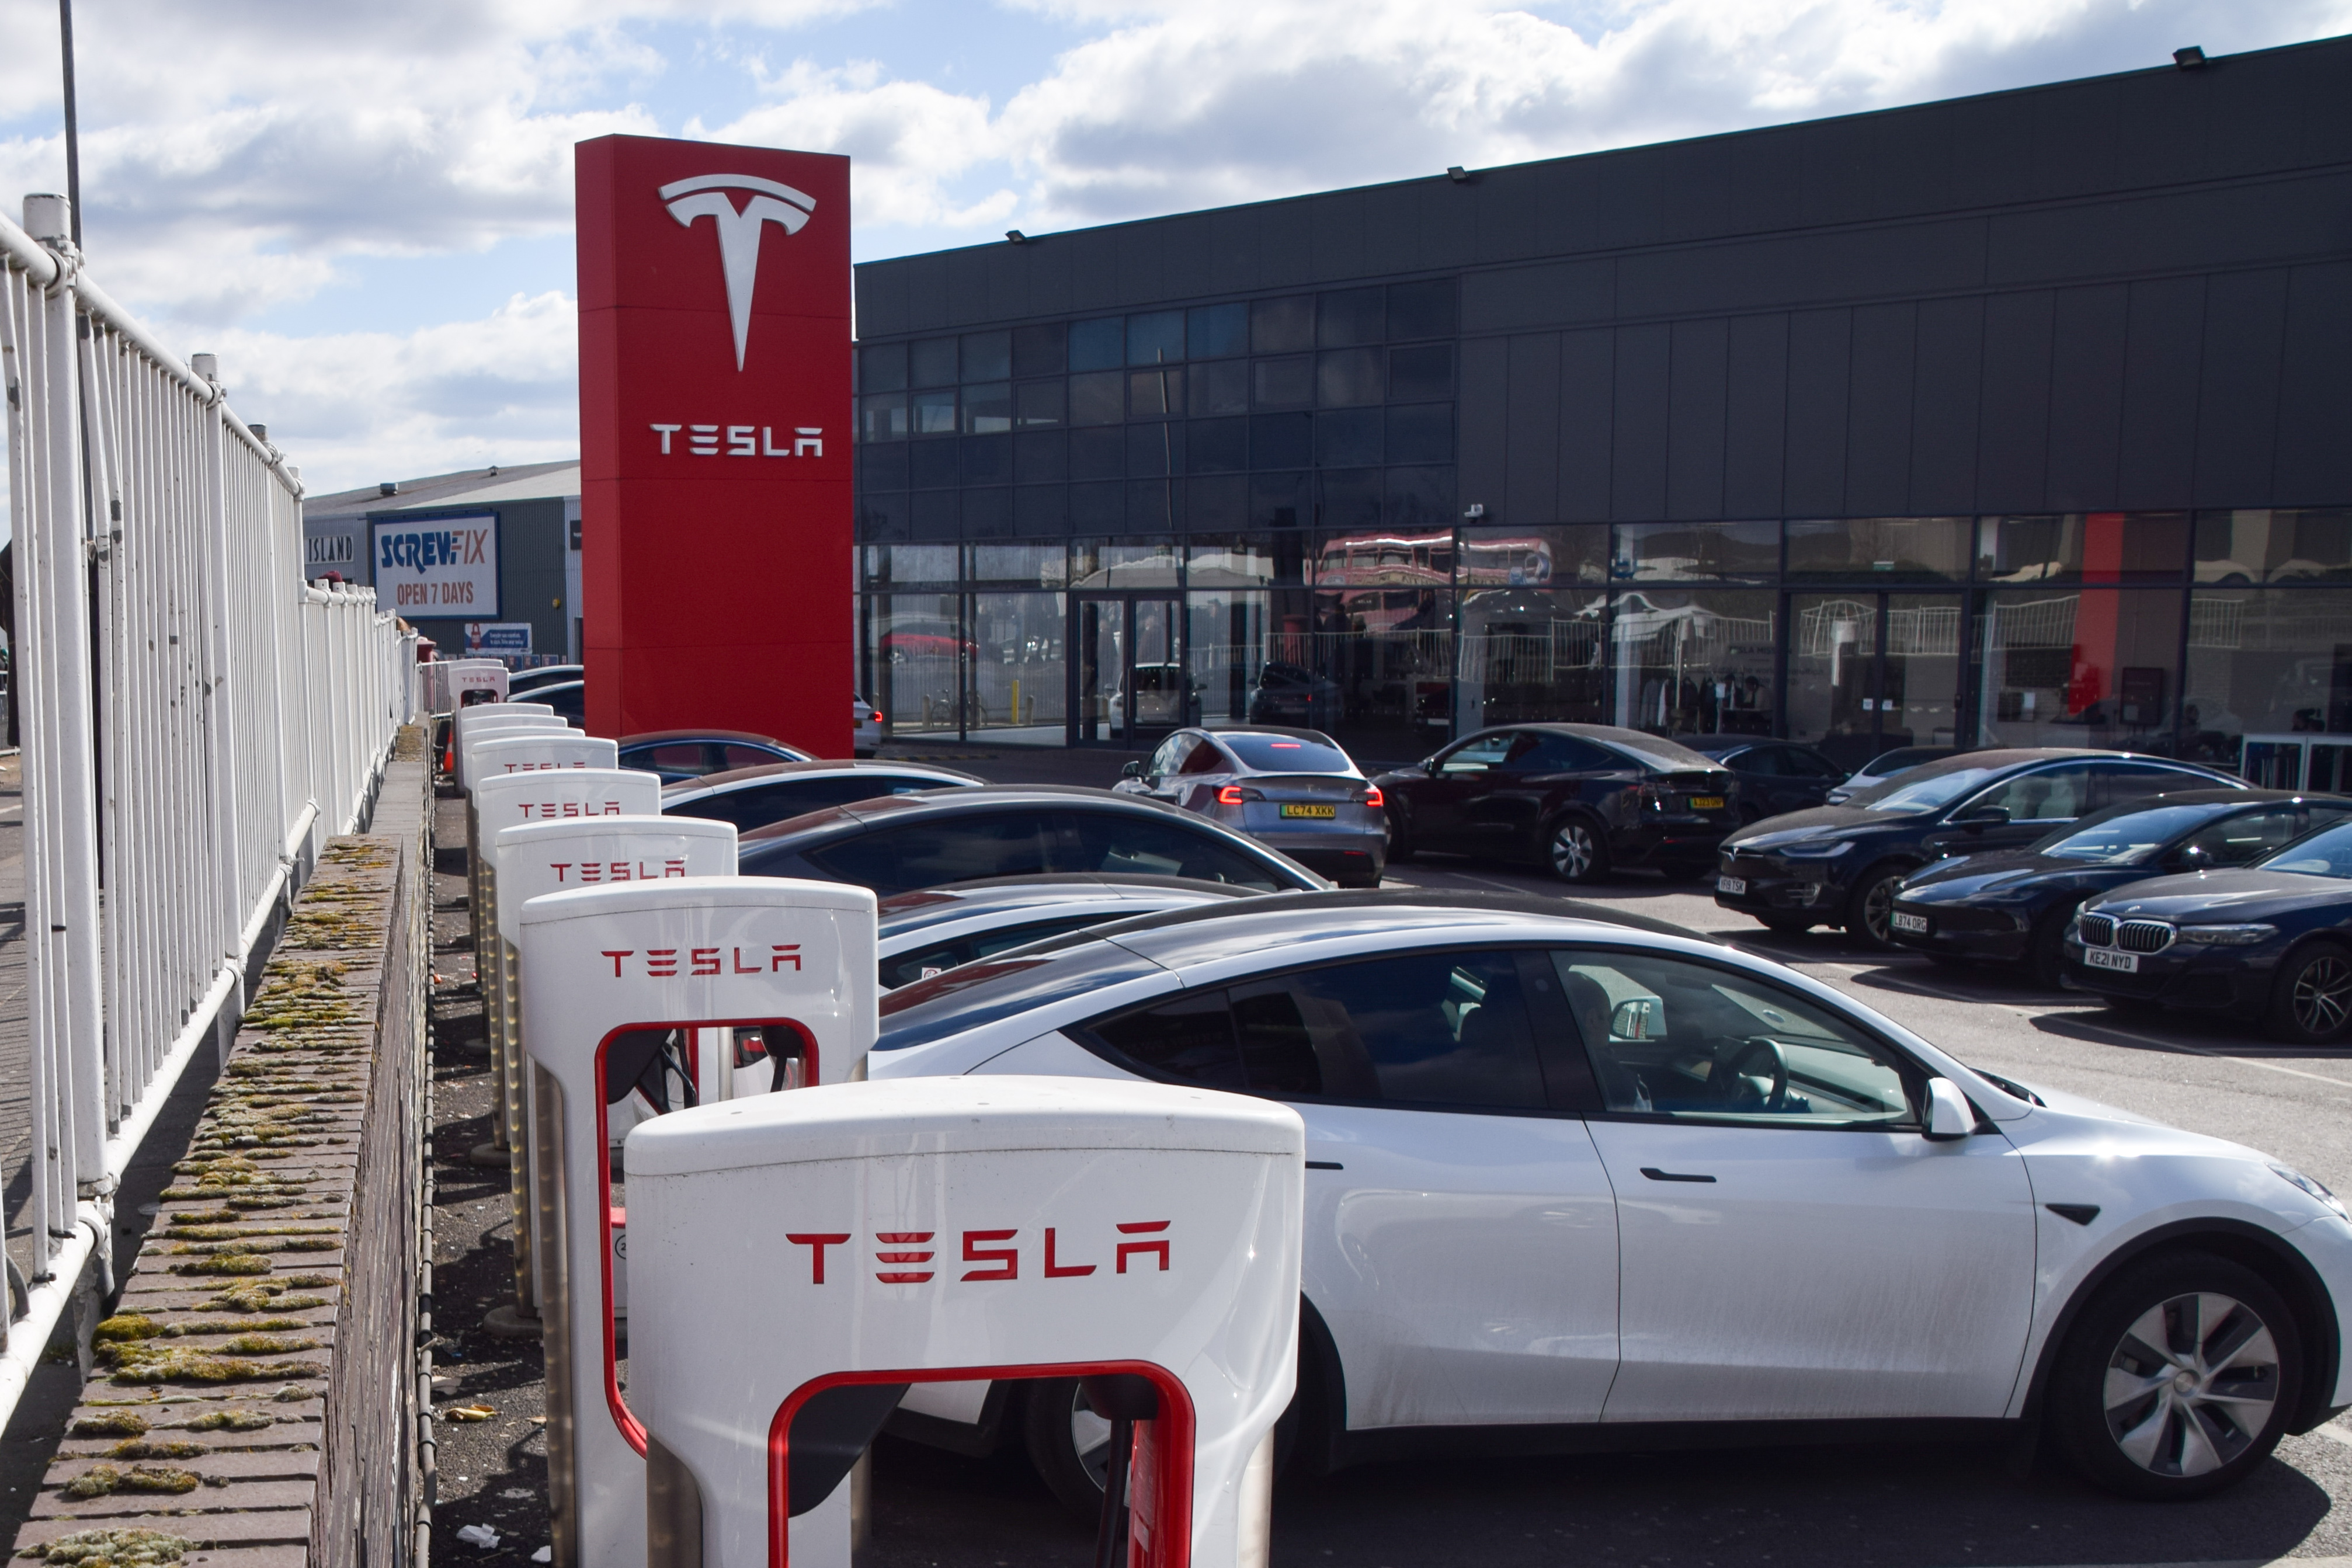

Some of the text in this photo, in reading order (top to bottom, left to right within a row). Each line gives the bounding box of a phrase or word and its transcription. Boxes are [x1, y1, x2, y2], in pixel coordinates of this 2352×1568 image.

[649, 423, 823, 457] TESLA
[308, 536, 352, 562] ISLAND
[381, 528, 488, 574] SCREWFIX
[397, 580, 474, 606] OPEN 7 DAYS
[517, 801, 620, 818] TESLA
[1287, 805, 1334, 815] LC74 XKK
[550, 860, 685, 882] TESLA
[1894, 913, 1910, 928] LB74
[601, 944, 801, 978] TESLA
[2089, 950, 2132, 969] KE21 NYD
[786, 1220, 1171, 1284] TESLA
